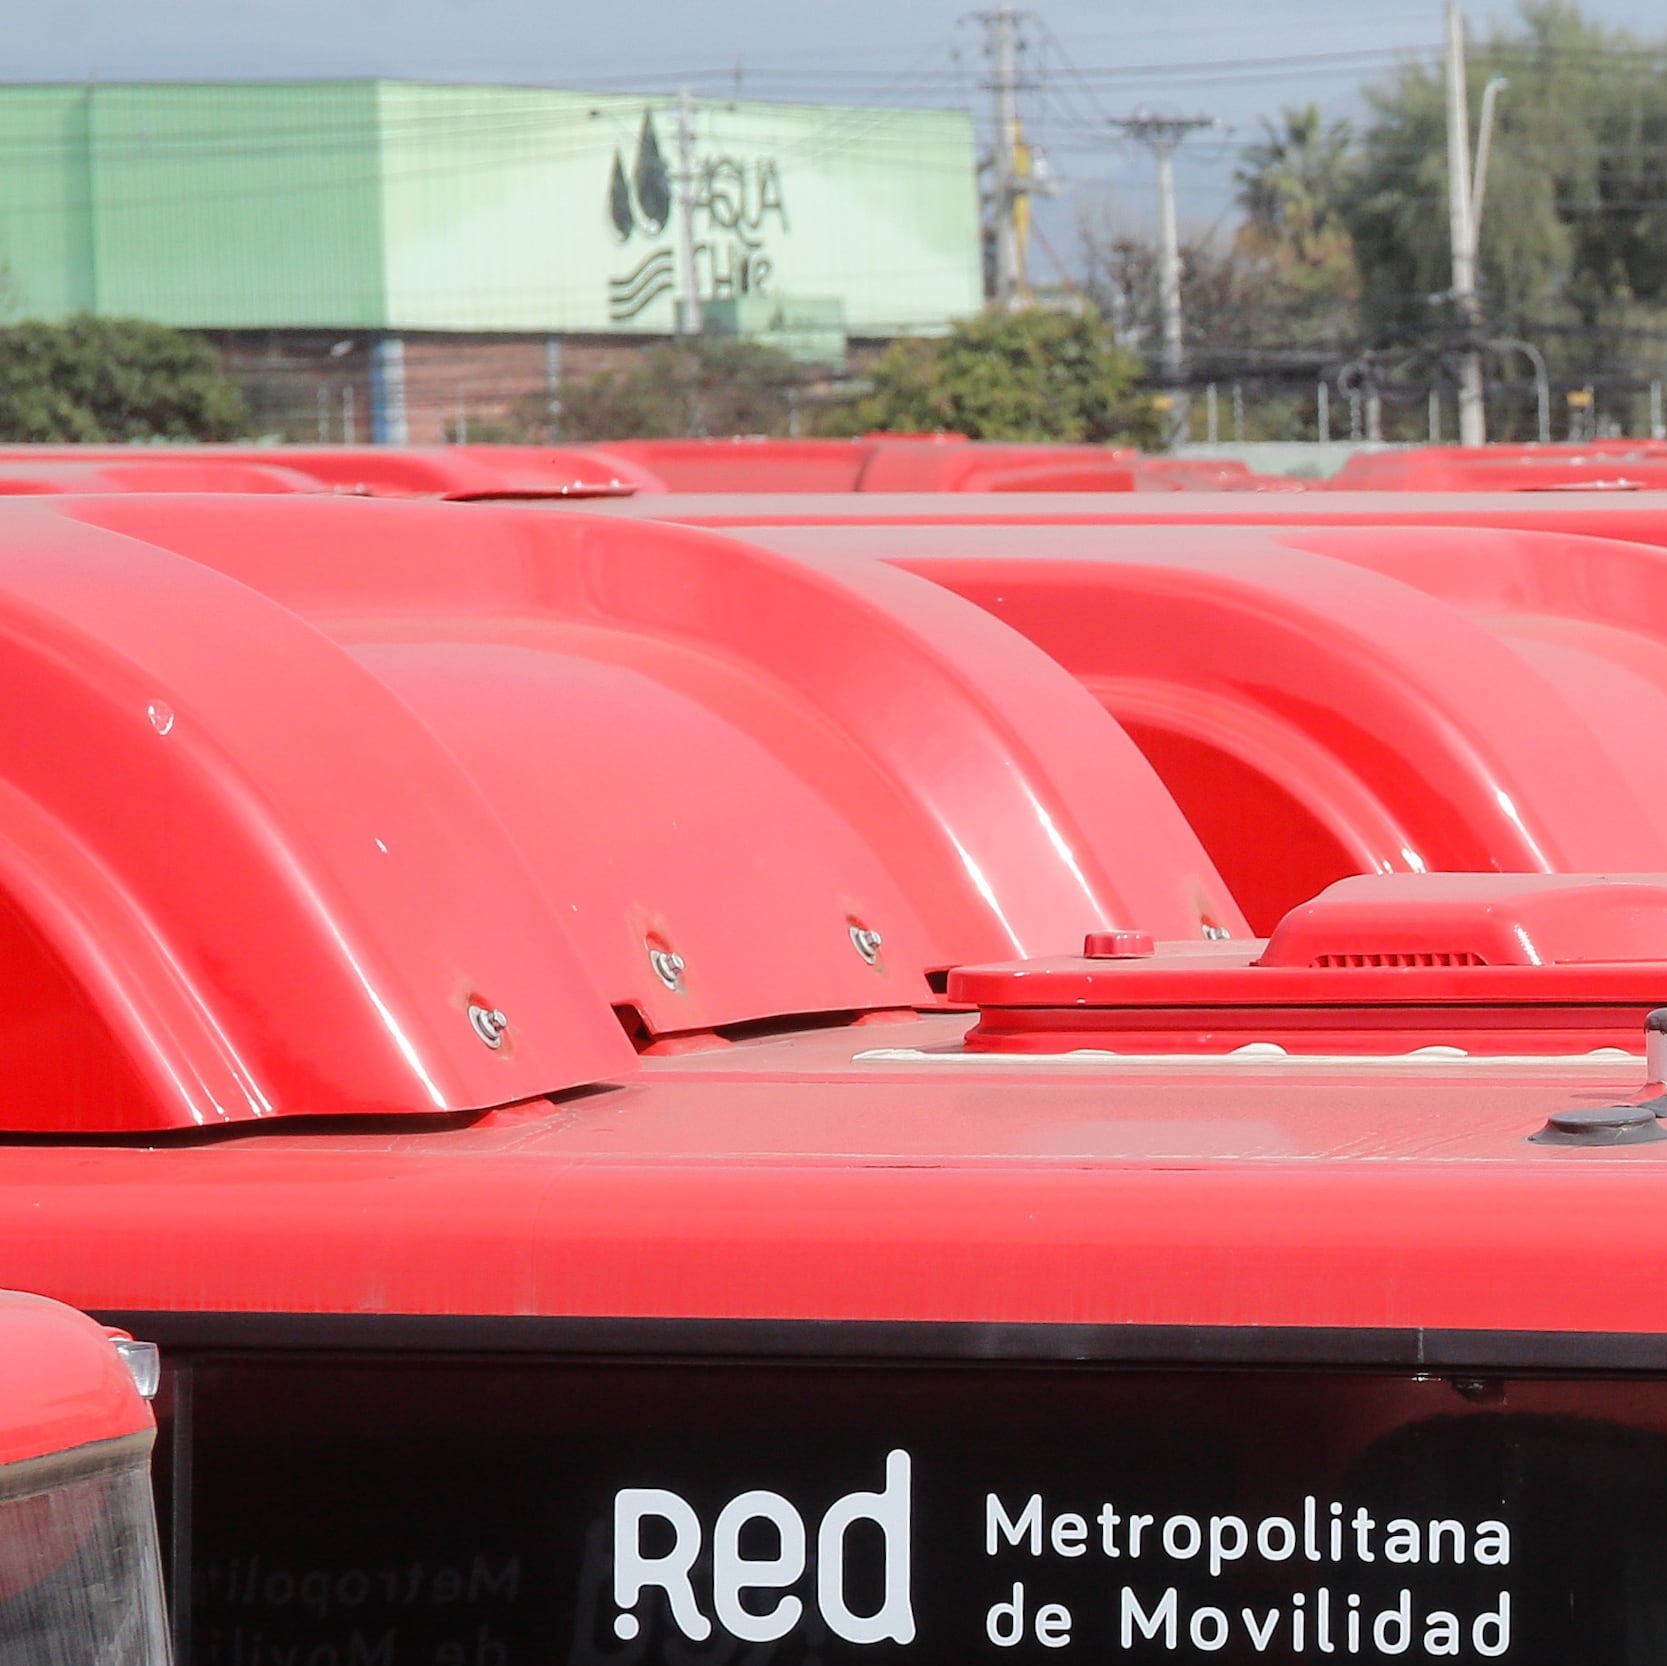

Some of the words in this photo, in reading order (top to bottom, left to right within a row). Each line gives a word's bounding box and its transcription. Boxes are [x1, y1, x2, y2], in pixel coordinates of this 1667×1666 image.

[613, 1449, 917, 1645] Red
[986, 1493, 1510, 1577] Metropolitana
[986, 1582, 1072, 1648] de
[1120, 1586, 1511, 1657] Movilidad
